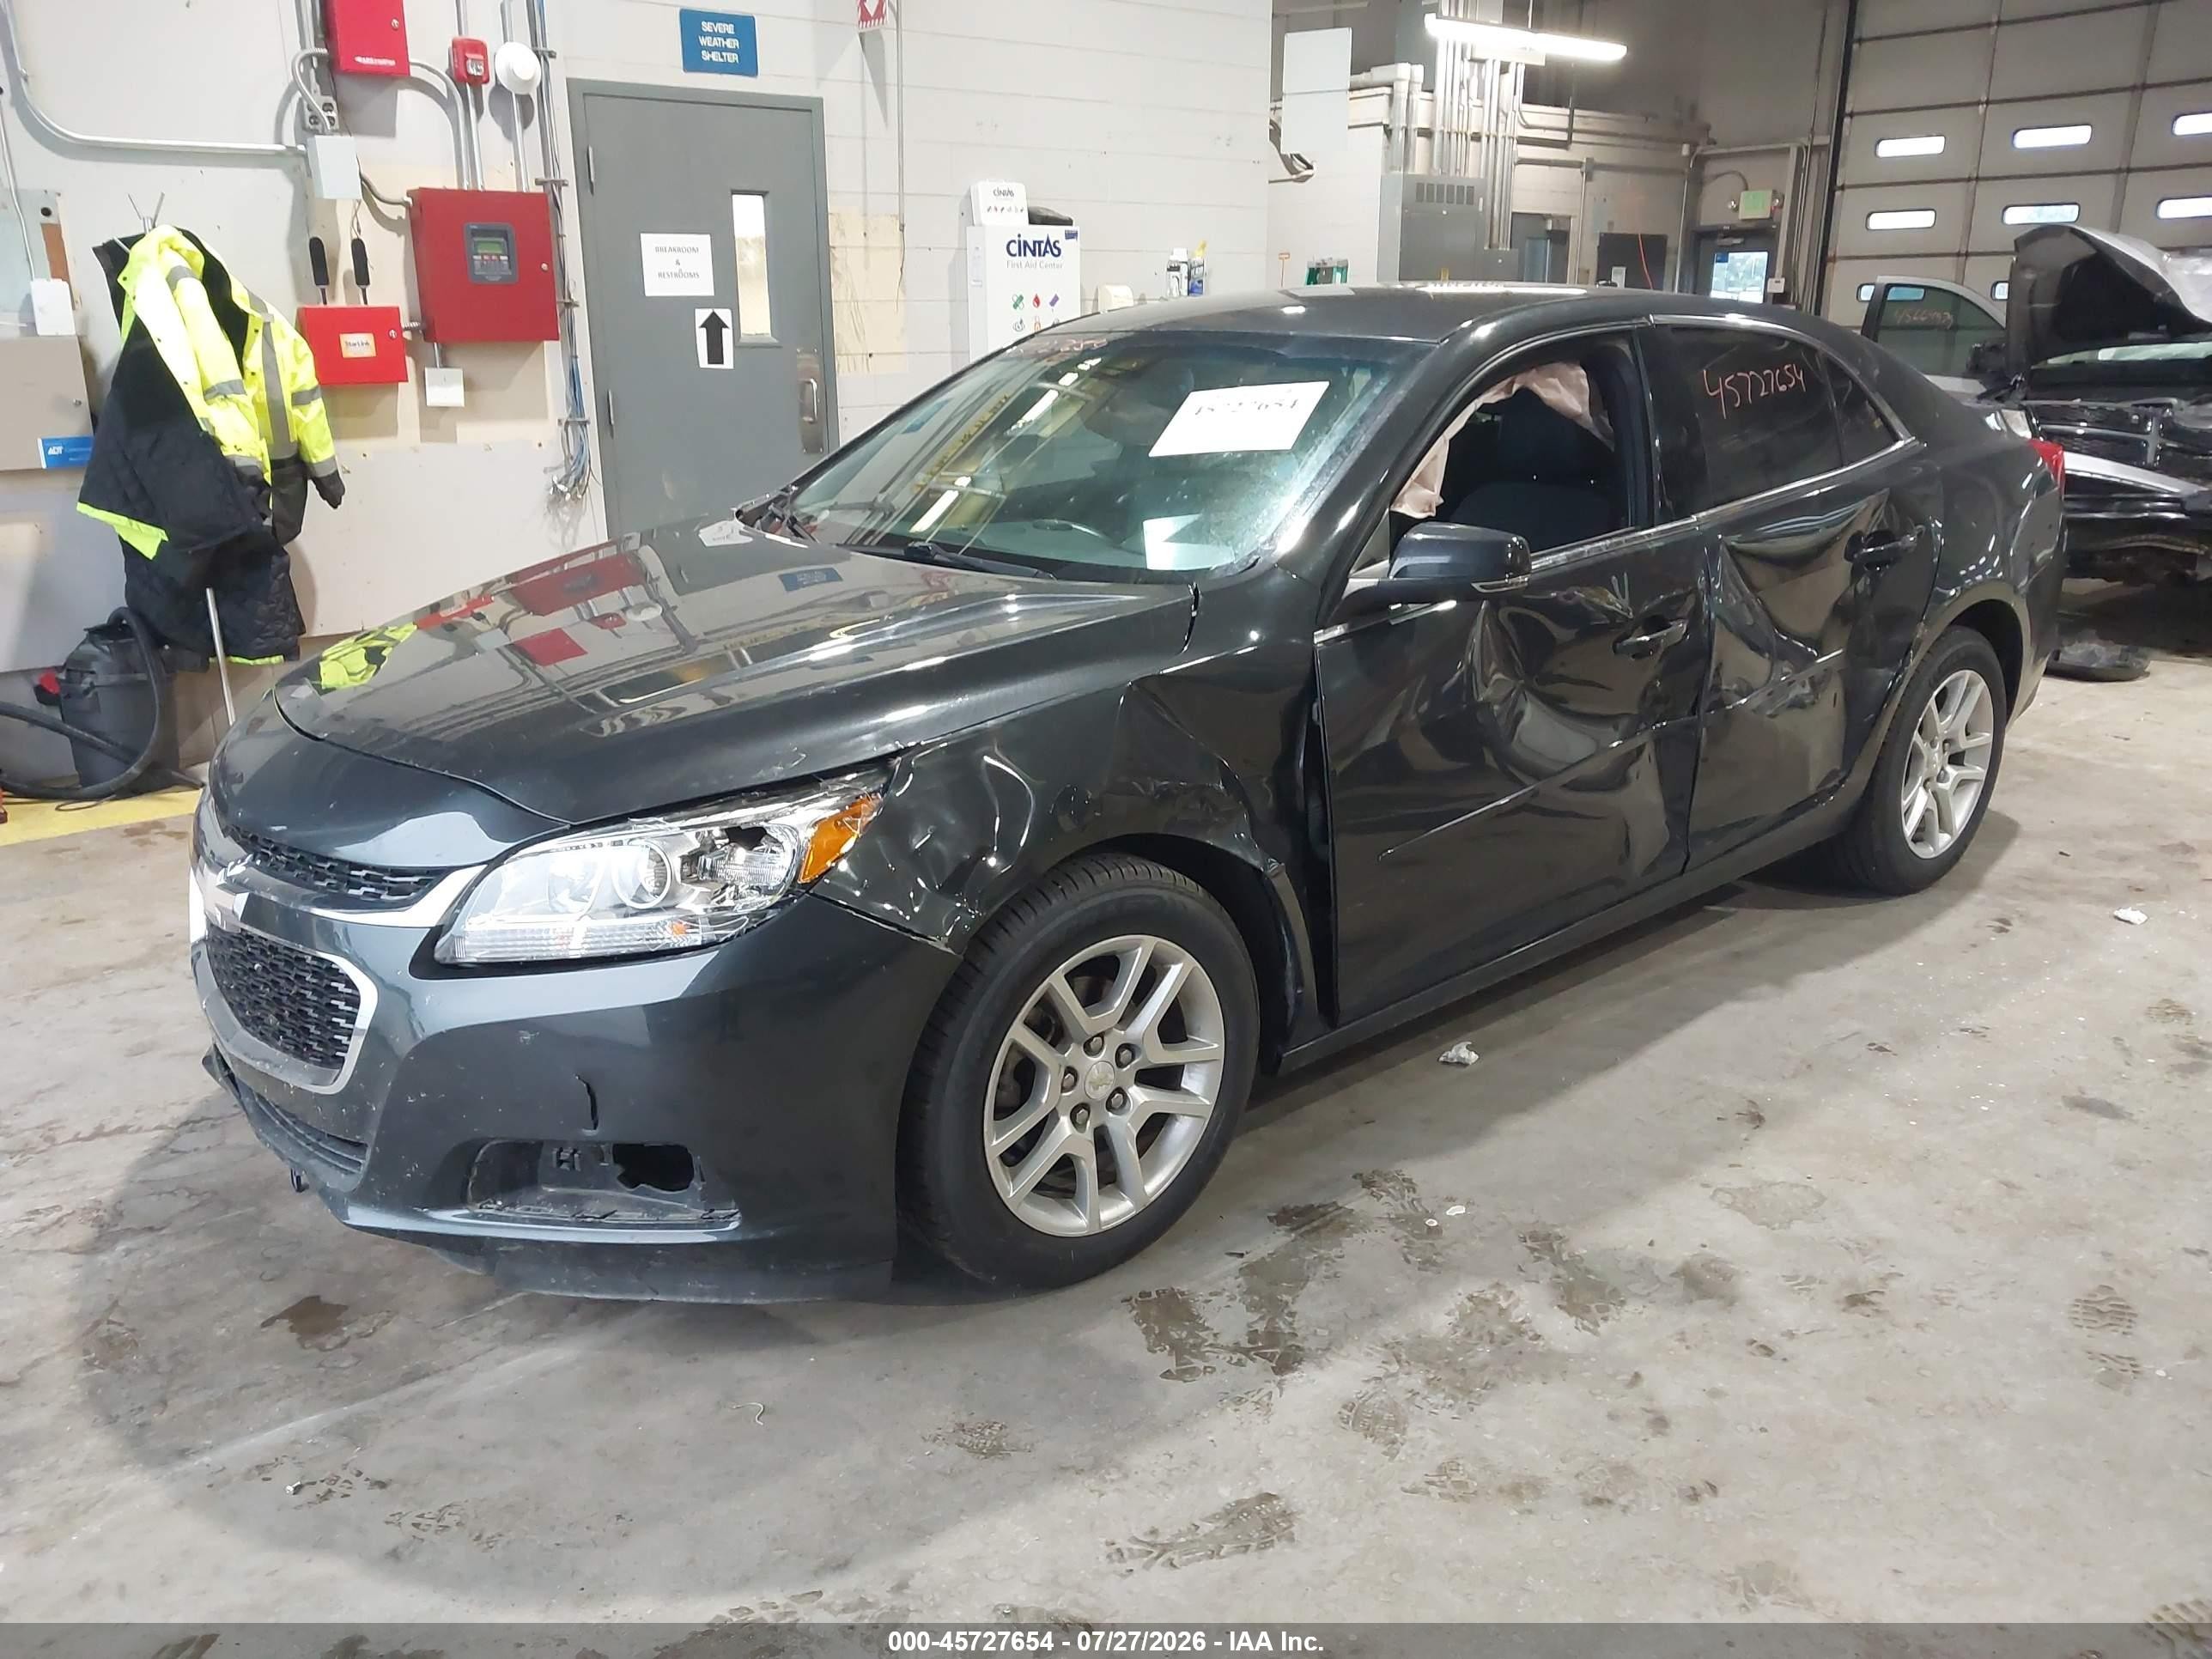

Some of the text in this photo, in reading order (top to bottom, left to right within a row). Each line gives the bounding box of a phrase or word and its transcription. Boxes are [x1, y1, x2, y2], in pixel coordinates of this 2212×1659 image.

[701, 21, 735, 34] SEVERE
[698, 35, 739, 49] WEATHER
[701, 50, 739, 64] SHELTER
[654, 246, 699, 254] BREAKROOM
[1024, 259, 1037, 269] Aid
[1703, 363, 1806, 419] 45727654
